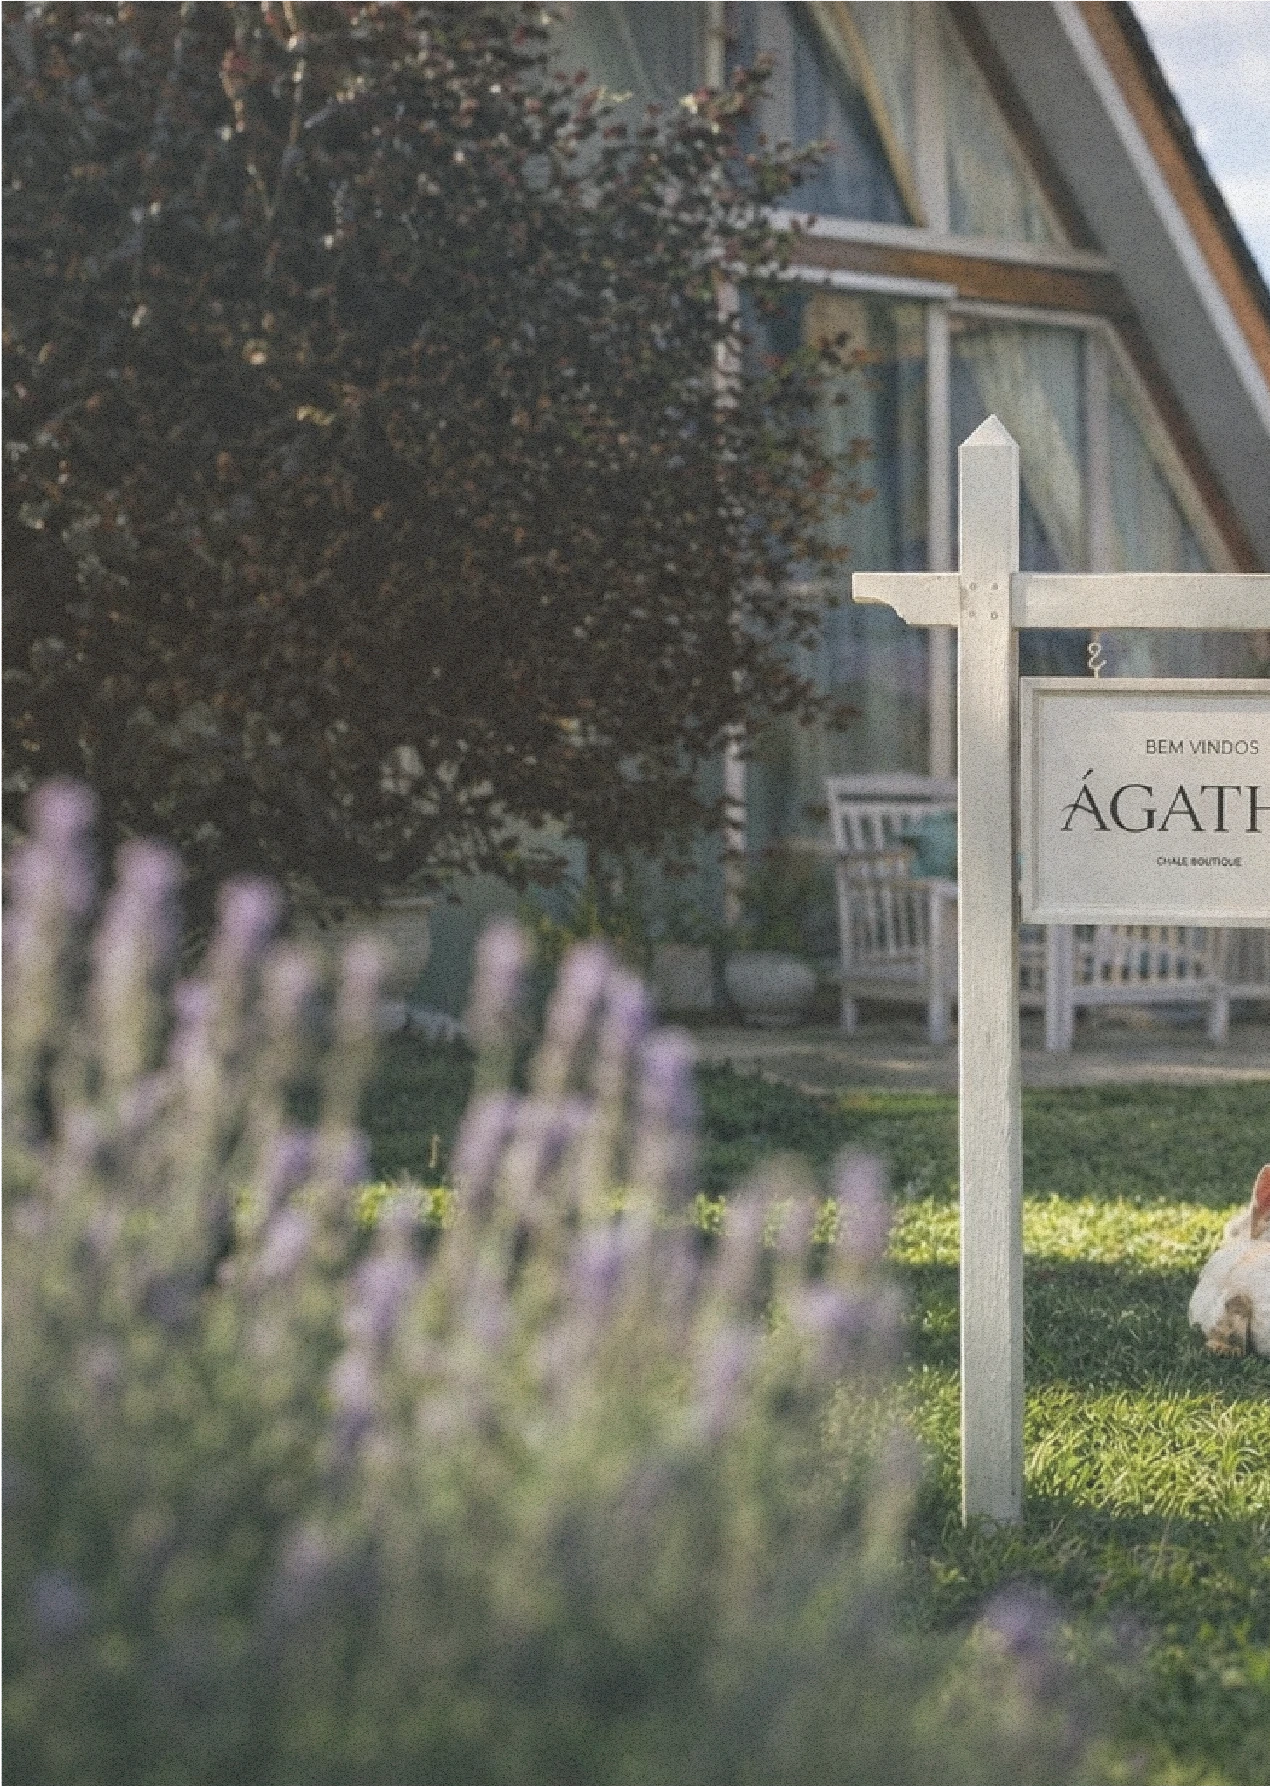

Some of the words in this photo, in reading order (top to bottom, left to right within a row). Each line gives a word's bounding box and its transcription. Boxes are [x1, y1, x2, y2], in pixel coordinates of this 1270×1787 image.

[1146, 739, 1184, 755] BEM
[1189, 739, 1260, 756] VINDOS
[1190, 856, 1242, 867] BOUTIQUE
